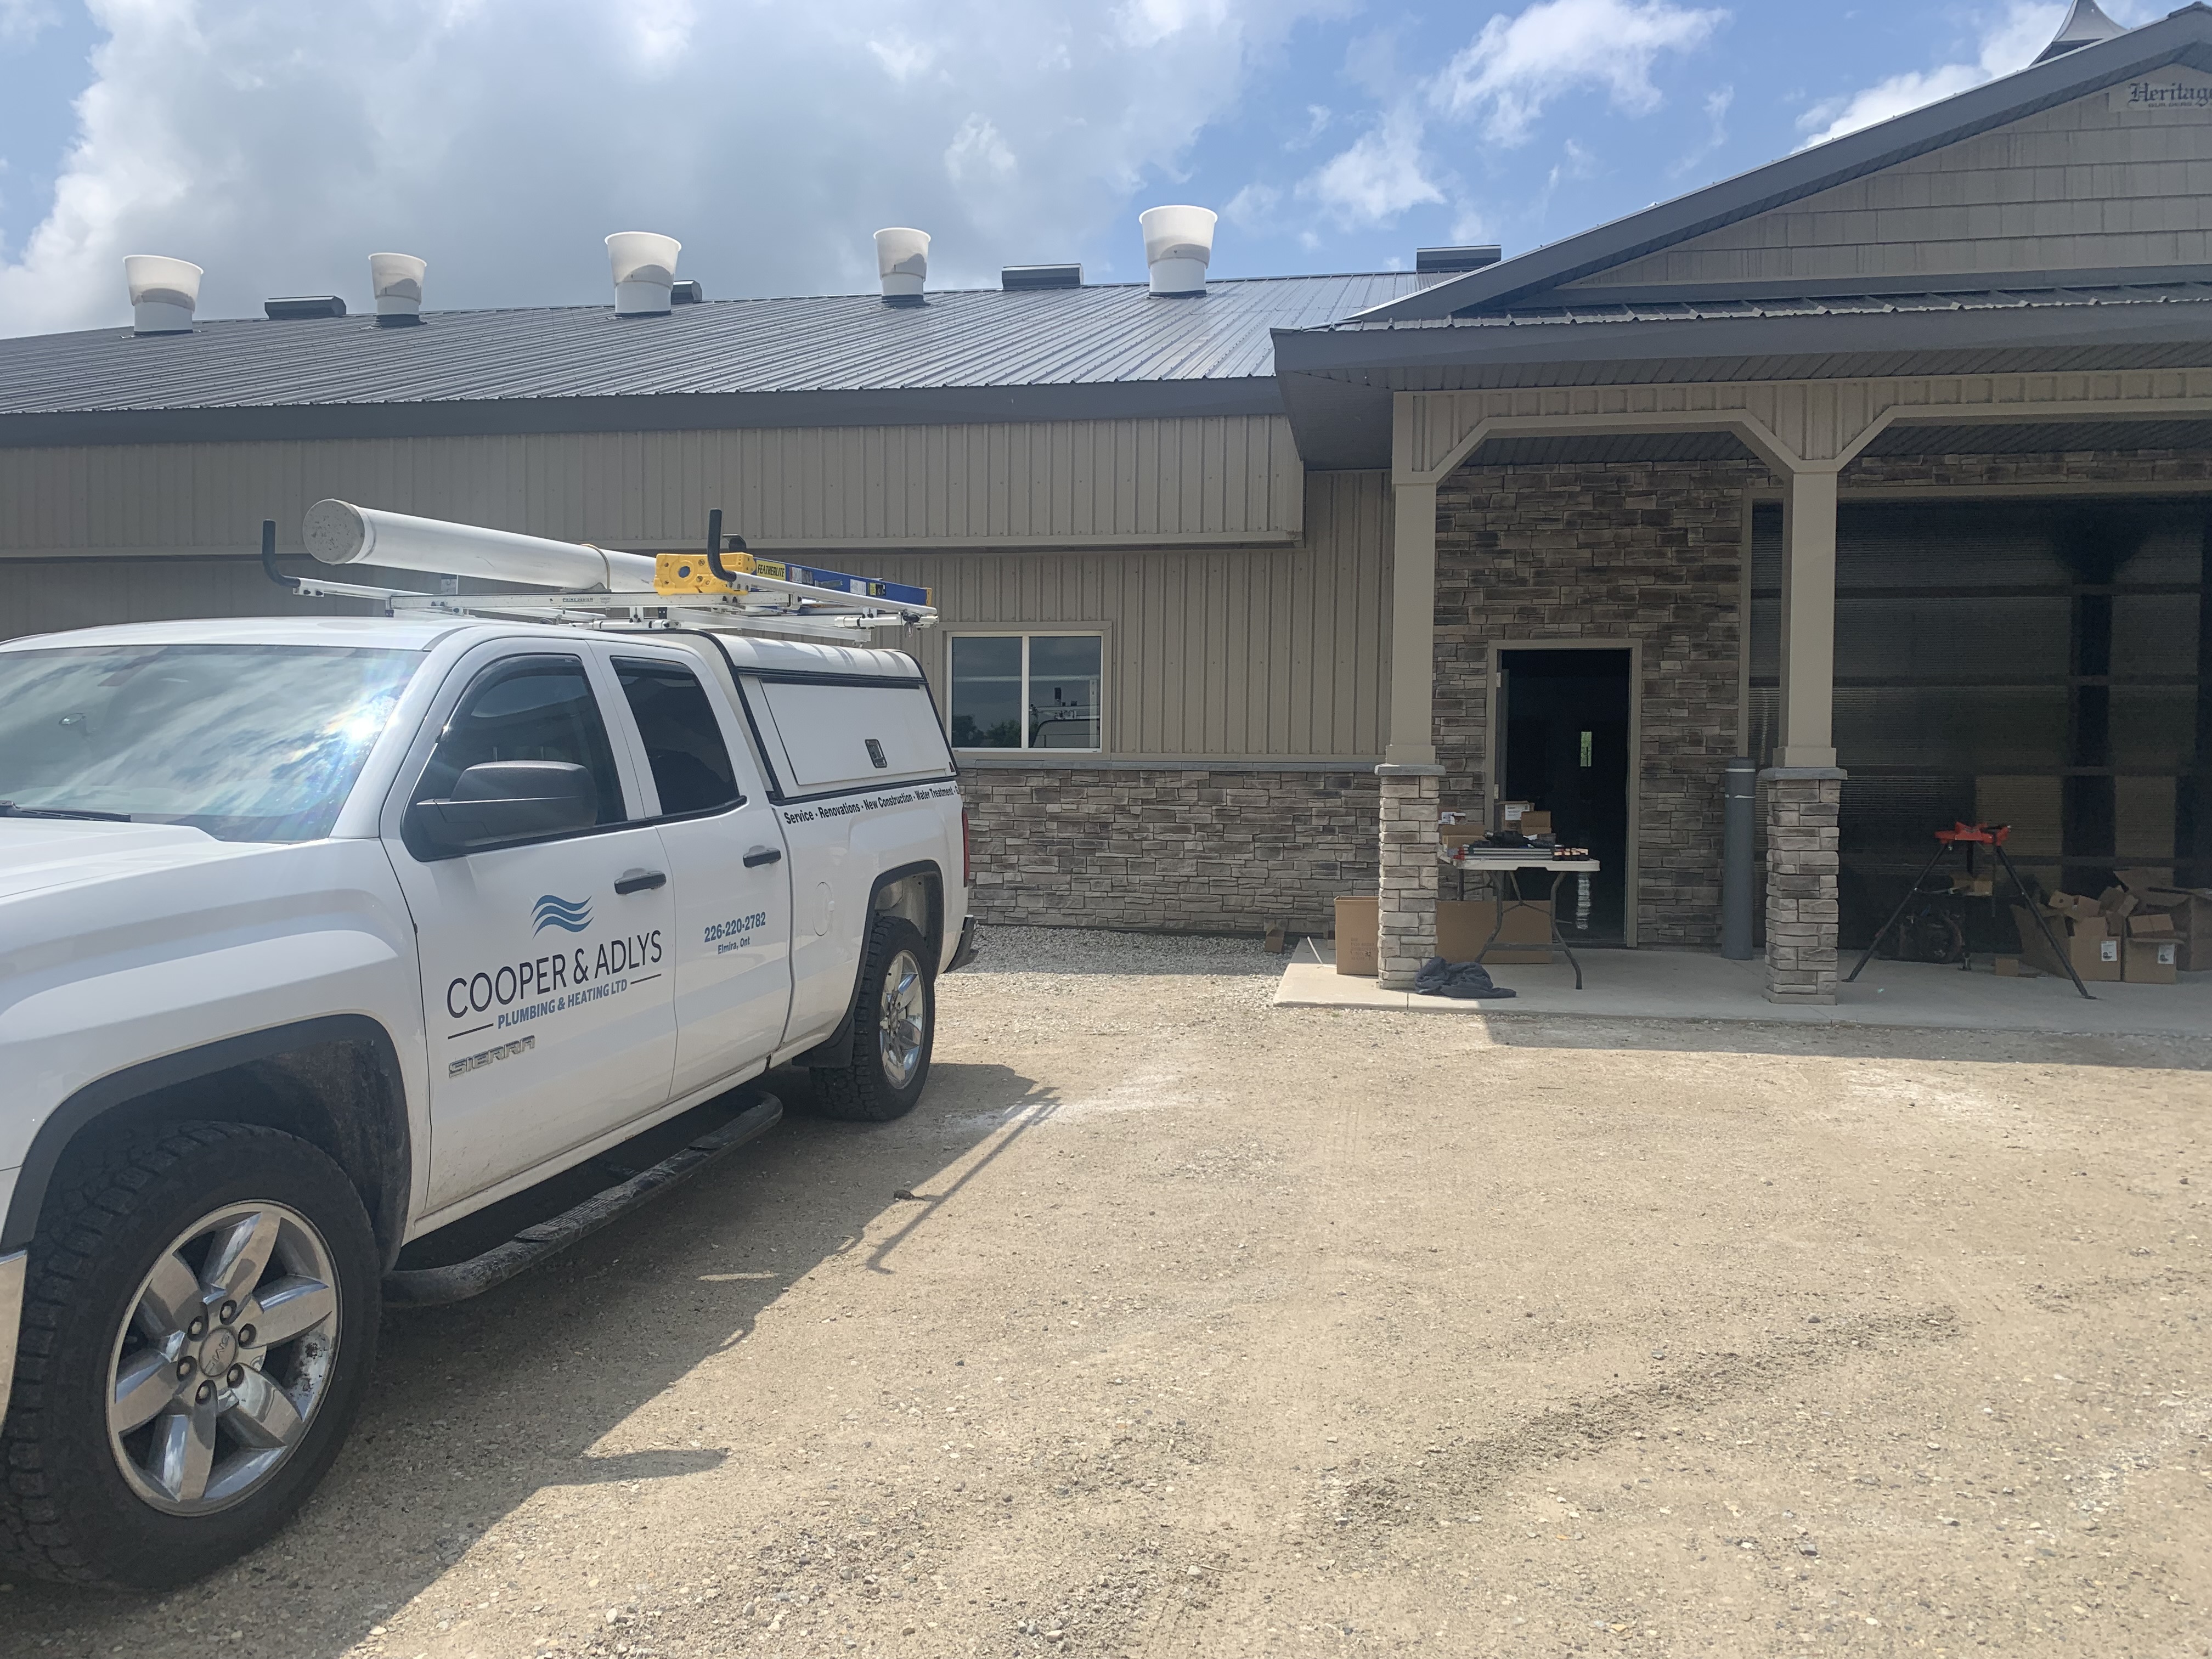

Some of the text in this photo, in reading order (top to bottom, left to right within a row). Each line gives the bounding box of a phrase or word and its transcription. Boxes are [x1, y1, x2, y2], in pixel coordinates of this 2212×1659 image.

[757, 564, 785, 578] FEATHERLITE
[784, 810, 814, 824] Service
[817, 802, 860, 819] Renovations
[863, 799, 878, 810] New
[878, 793, 913, 808] Construction
[915, 790, 930, 800] Water
[929, 786, 954, 798] Treatment
[704, 911, 766, 943] 226-220-2782
[718, 936, 750, 955] Elmira, Ont
[447, 930, 662, 1019] COOPER & ADLYS
[498, 979, 628, 1029] PLUMBING & HEATING LTD
[449, 1035, 535, 1079] SIERRA
